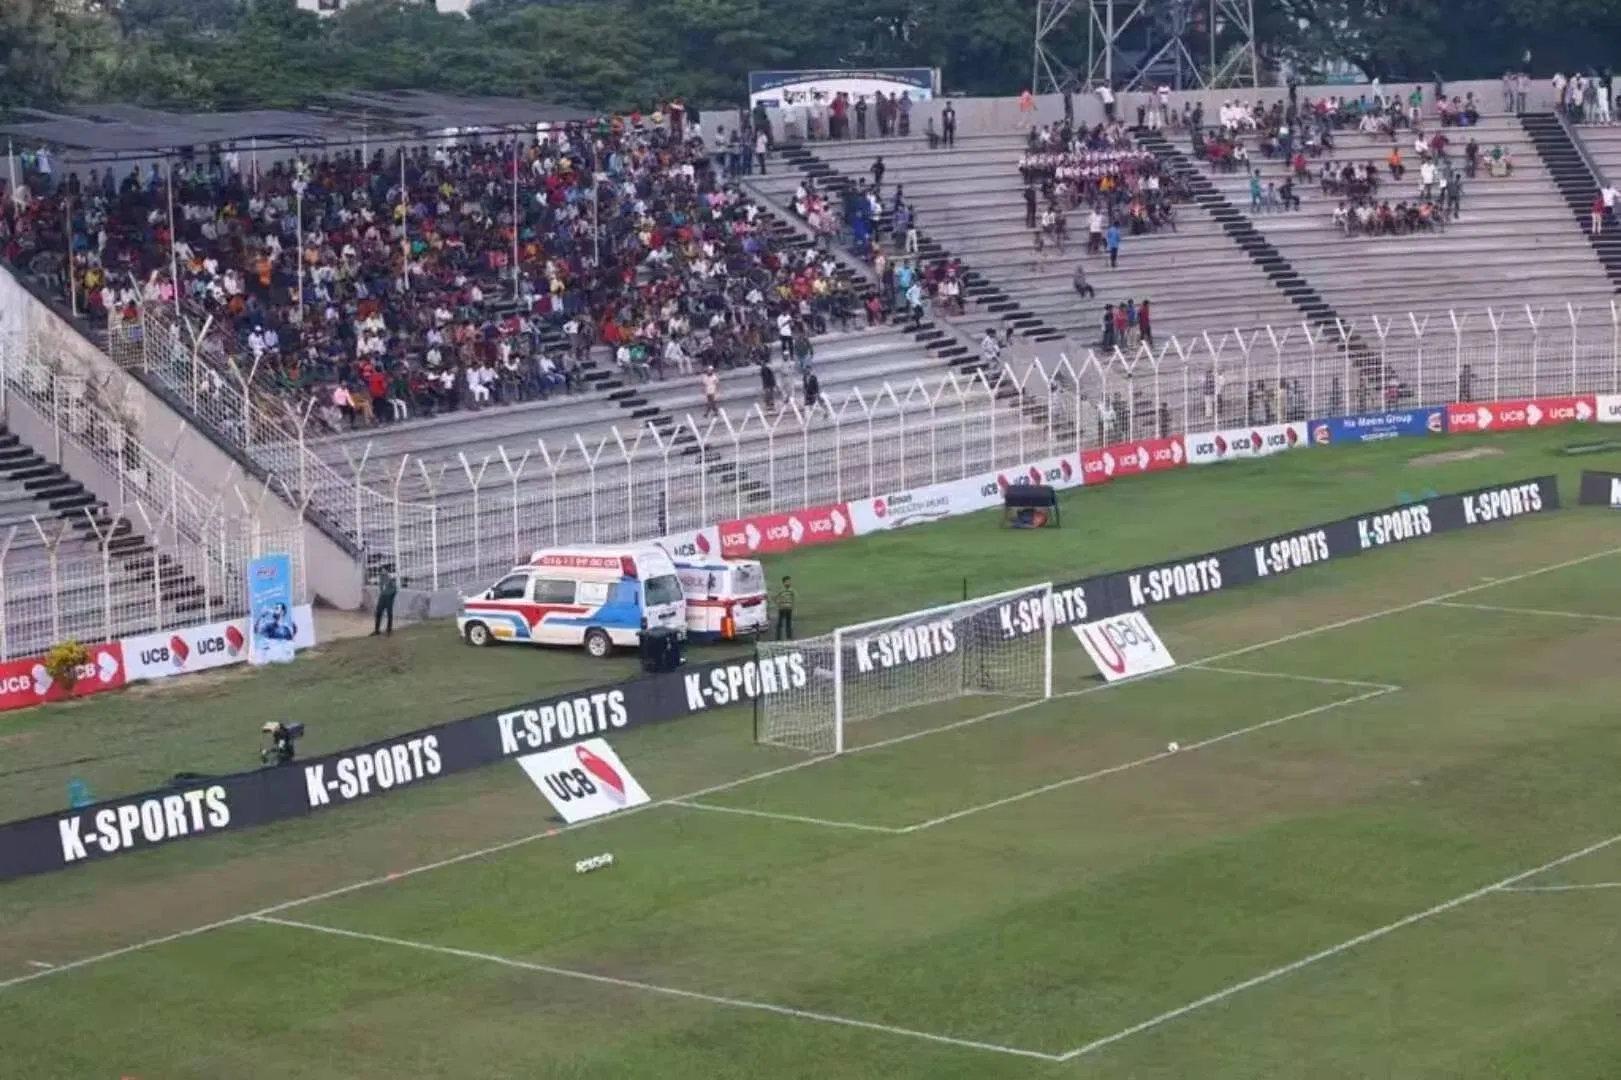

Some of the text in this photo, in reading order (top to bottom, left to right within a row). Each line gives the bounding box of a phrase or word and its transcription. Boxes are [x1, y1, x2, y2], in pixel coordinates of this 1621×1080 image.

[1386, 414, 1413, 425] Group
[1450, 407, 1575, 425] UCB UCB UCB
[1084, 448, 1171, 473] UCB UCB UCB
[1196, 433, 1286, 455] UCB UCB UCB
[981, 482, 998, 497] UCB
[1046, 468, 1062, 482] UCB
[1463, 483, 1543, 525] K-SPORTS
[722, 518, 833, 548] UCB UCB UCB
[1357, 505, 1433, 549] K-SPORTS
[1254, 530, 1330, 577] K-SPORTS
[1128, 557, 1223, 607] K-SPORTS
[1000, 587, 1088, 640] K-SPORTS
[140, 636, 226, 665] UCB UCB
[856, 622, 957, 673] K-SPORTS
[1081, 612, 1158, 674] Upay
[685, 653, 807, 711] K-SPORTS
[497, 690, 629, 755] K-SPORTS
[305, 735, 443, 807] K-SPORTS
[543, 766, 598, 803] UCB
[58, 785, 231, 863] K-SPORTS
